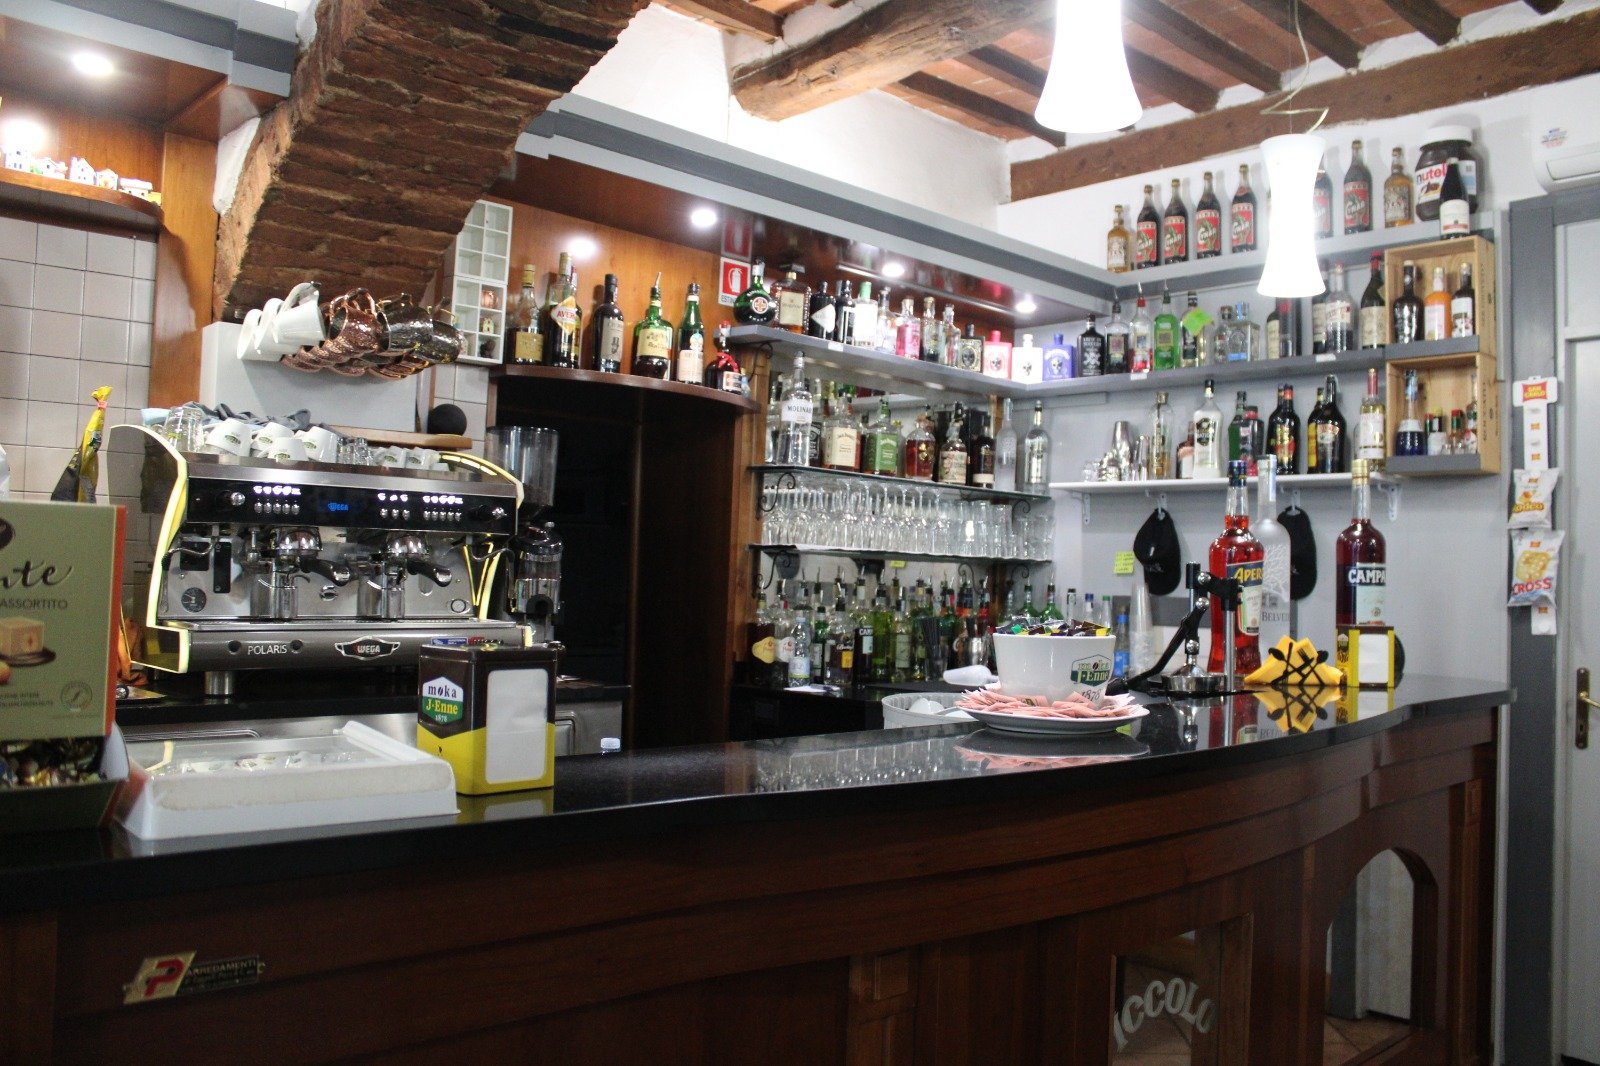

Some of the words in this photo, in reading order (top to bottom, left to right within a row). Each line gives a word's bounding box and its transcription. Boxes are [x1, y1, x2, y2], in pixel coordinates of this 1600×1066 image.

[1416, 162, 1449, 183] nutel
[1234, 567, 1264, 584] APER
[248, 644, 288, 656] POLARIS
[357, 644, 381, 654] WEGA
[428, 684, 457, 698] moka
